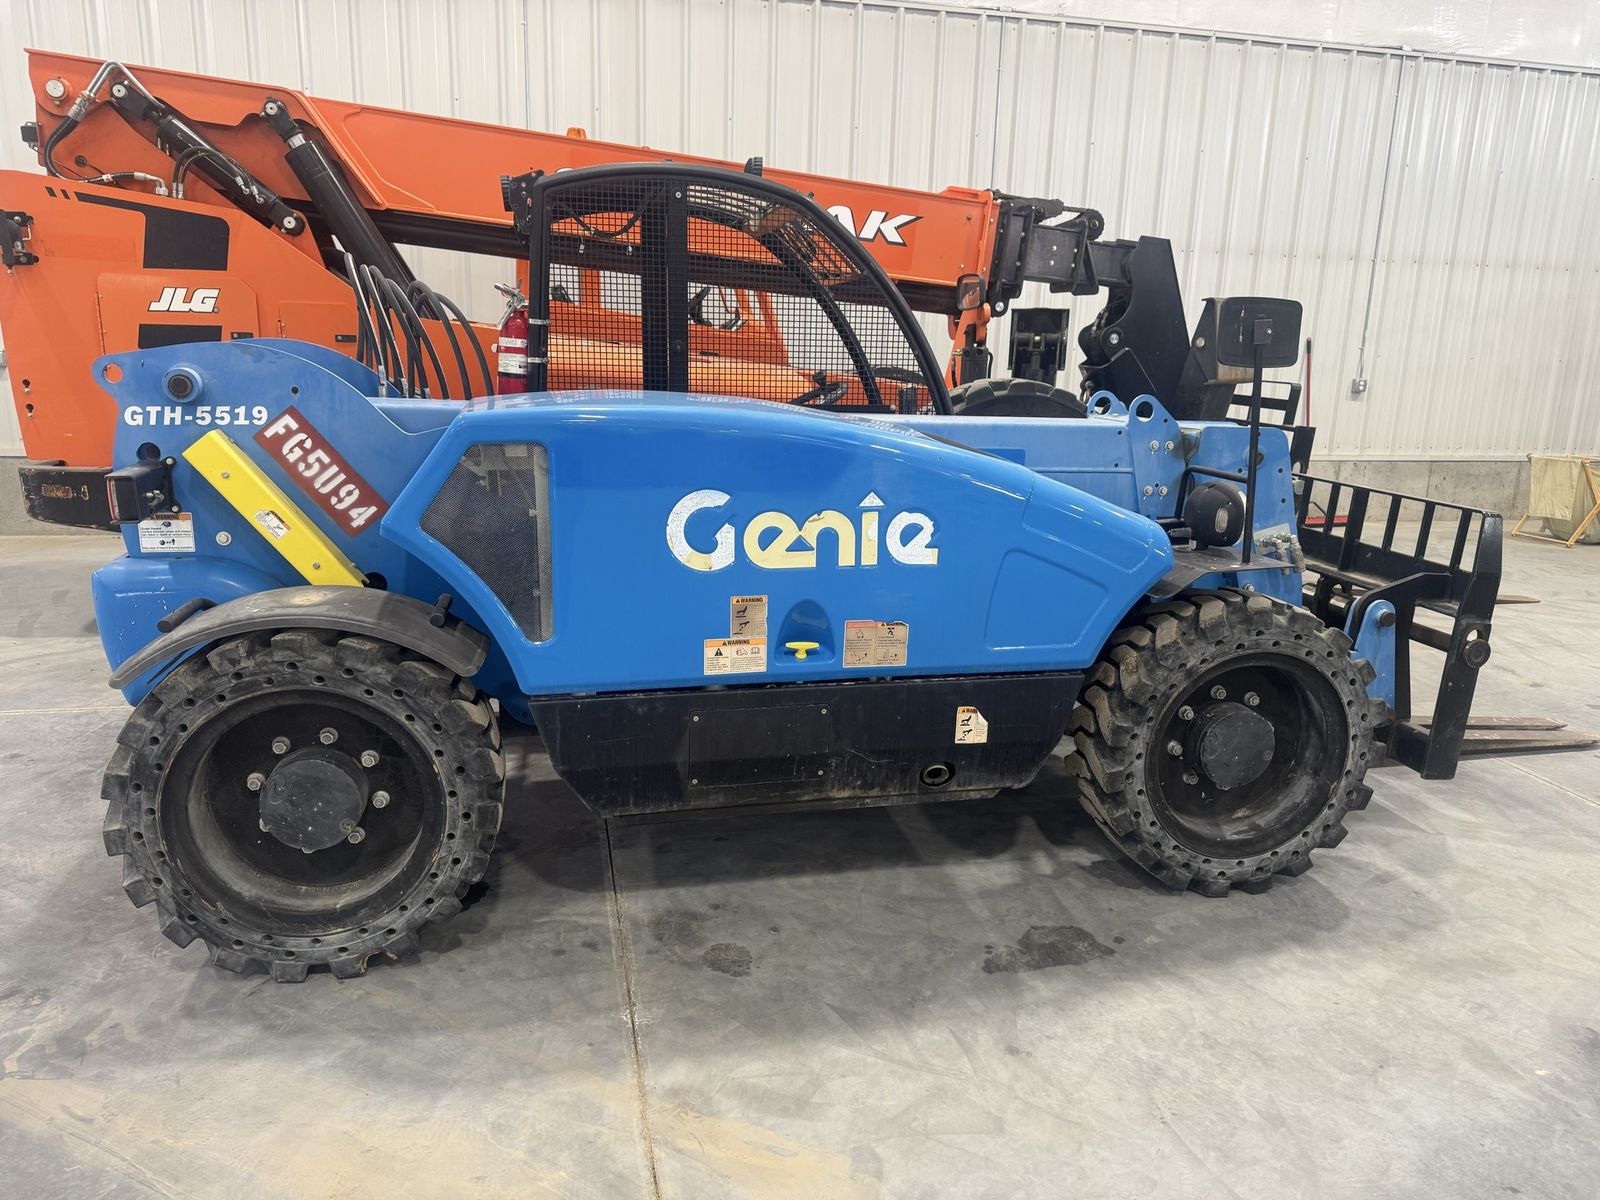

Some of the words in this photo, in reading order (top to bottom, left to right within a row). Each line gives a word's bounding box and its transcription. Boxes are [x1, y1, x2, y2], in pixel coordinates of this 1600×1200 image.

[148, 287, 220, 313] JLG
[124, 405, 268, 426] GTH-5519
[263, 414, 378, 528] FG5U94
[666, 489, 939, 571] Genie
